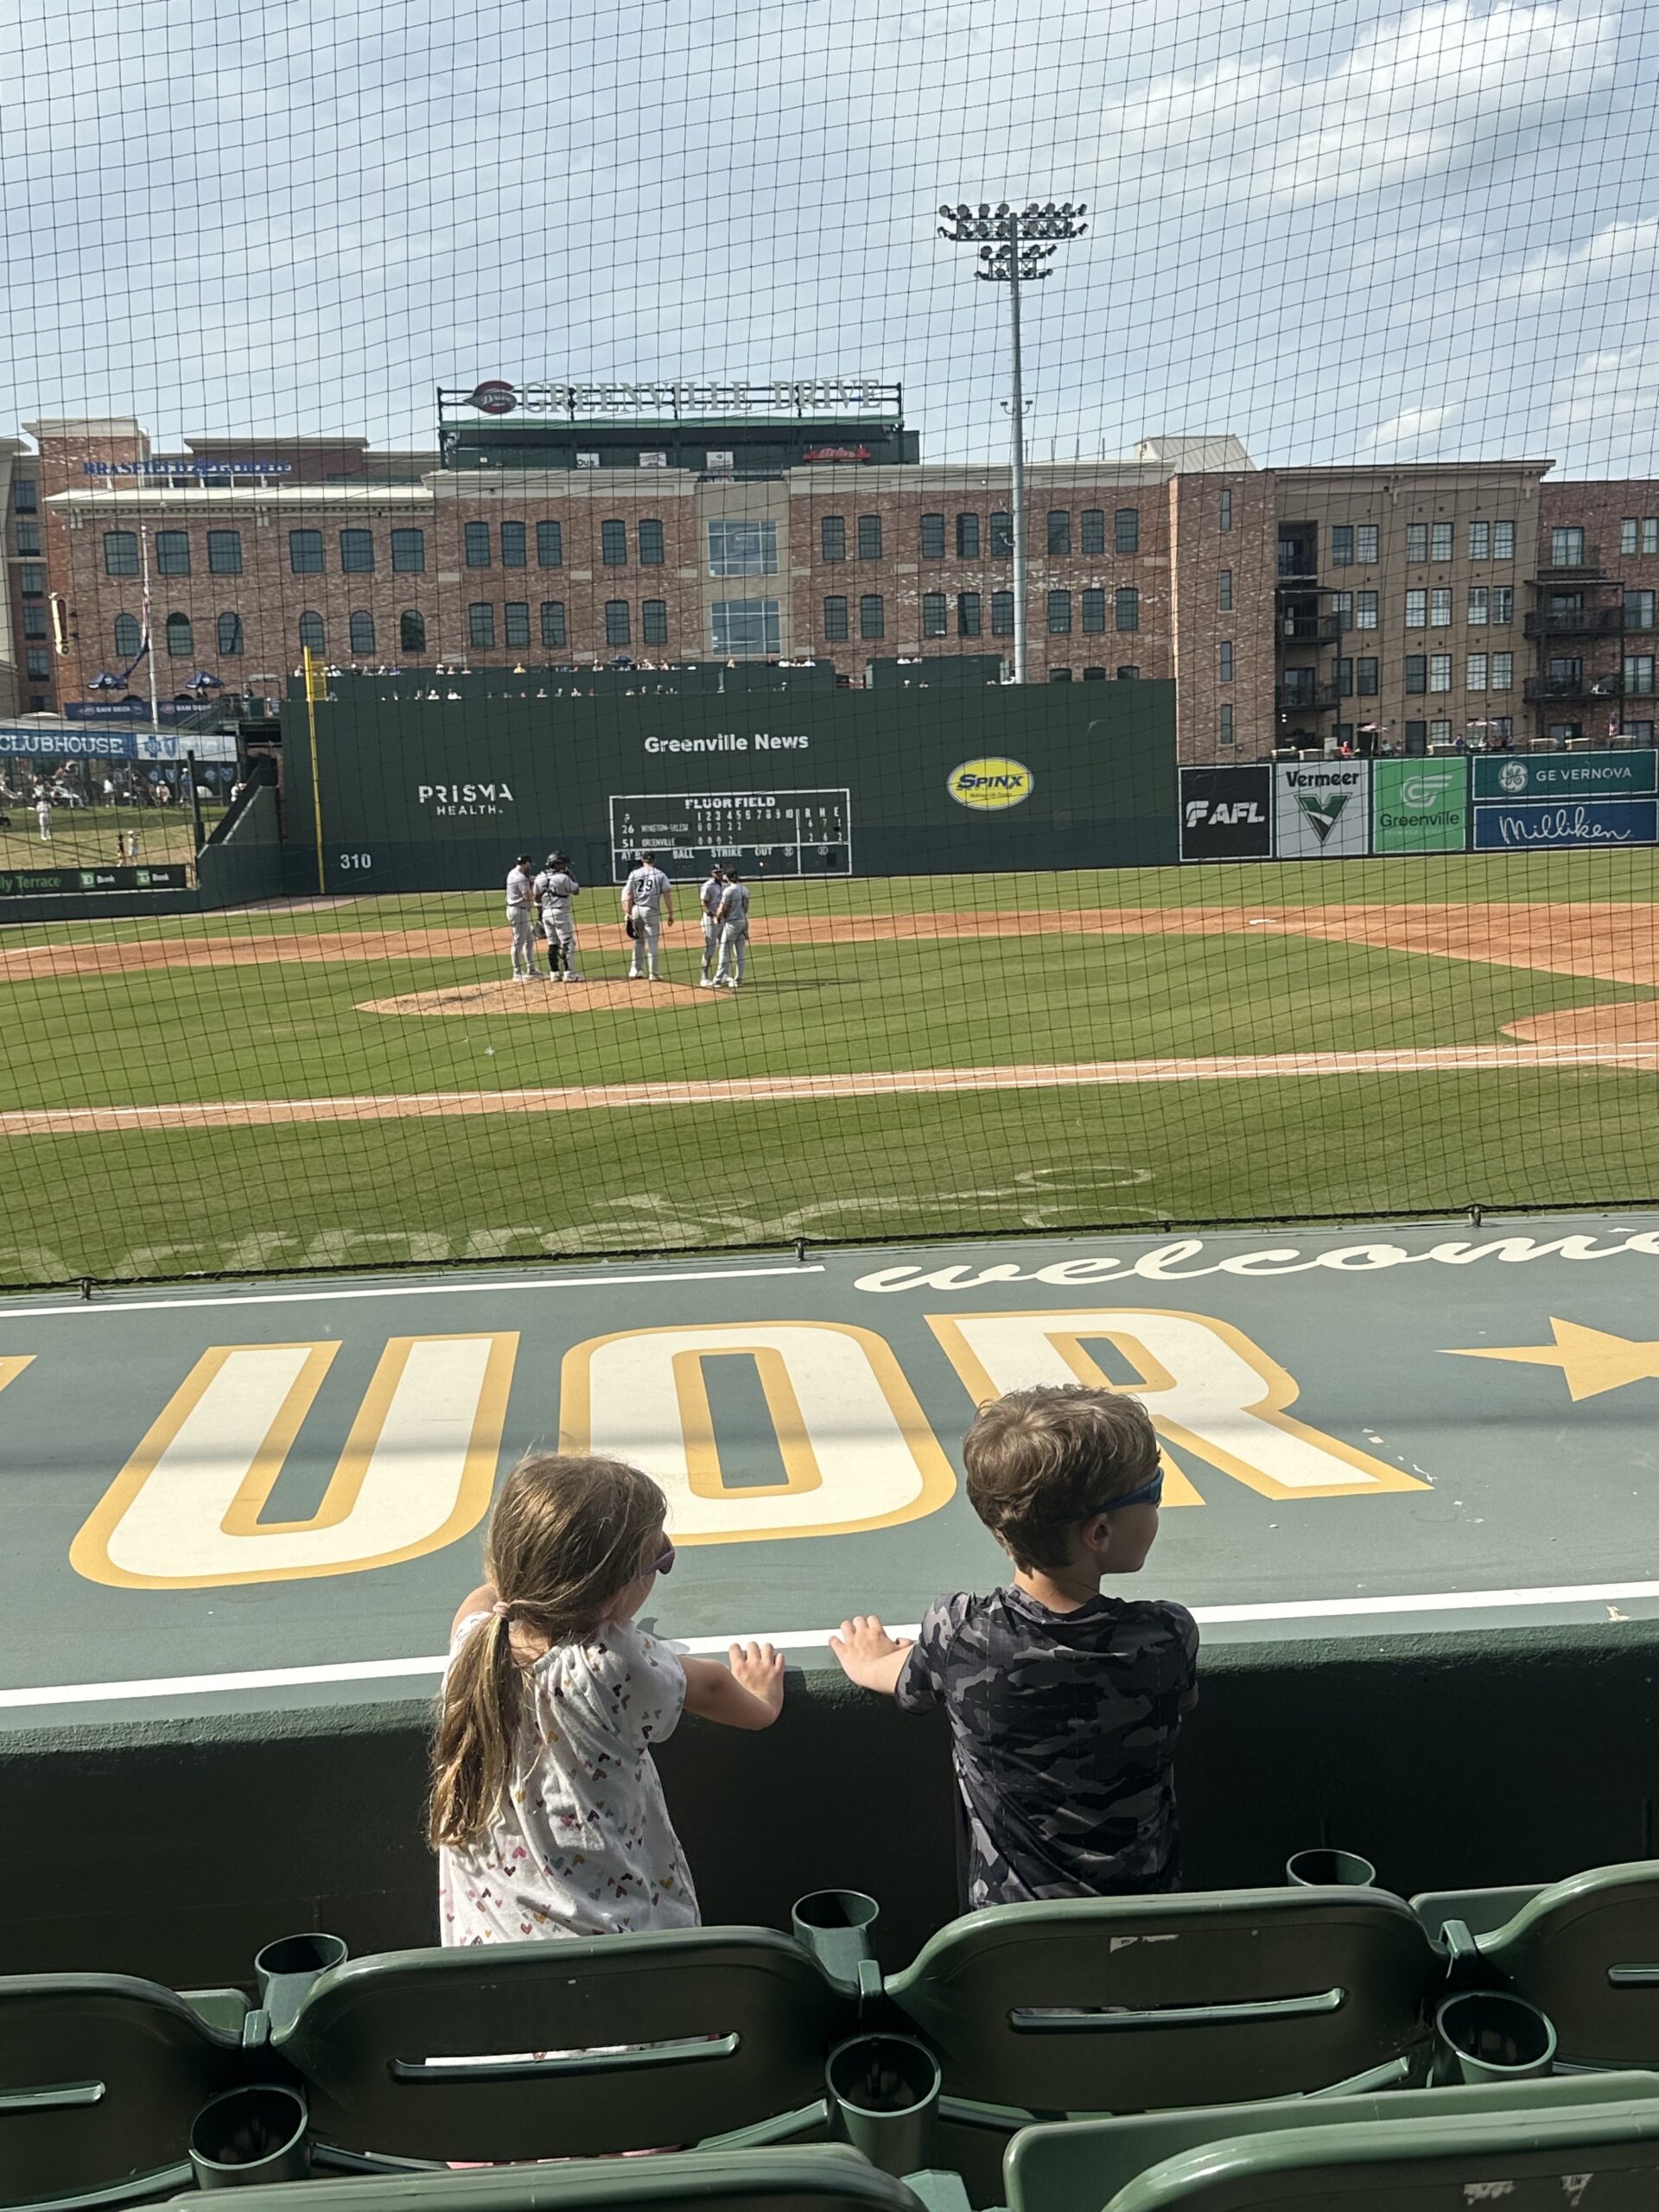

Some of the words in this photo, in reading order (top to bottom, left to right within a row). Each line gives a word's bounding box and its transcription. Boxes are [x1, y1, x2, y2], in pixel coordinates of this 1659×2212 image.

[523, 381, 752, 413] GREENVILLE
[772, 379, 880, 410] DRIVE
[0, 734, 124, 753] CLUBHOUSE
[644, 734, 748, 753] Greenville
[754, 733, 809, 751] News
[1286, 771, 1359, 787] Vermeer
[1536, 770, 1556, 781] GE
[1560, 767, 1632, 780] VERNOVA
[418, 783, 514, 804] PRISMA
[684, 798, 733, 810] FLUOR
[734, 797, 776, 808] FIELD
[1380, 811, 1459, 827] Greenville
[1499, 806, 1631, 845] Milliken
[622, 824, 634, 834] 26
[622, 838, 633, 848] 51
[340, 853, 372, 869] 310
[672, 849, 695, 860] BALL
[710, 848, 742, 858] STRIKE
[754, 847, 772, 856] OUT
[16, 875, 61, 888] Terrace
[637, 879, 653, 893] 29
[0, 1307, 1434, 1589] UOR
